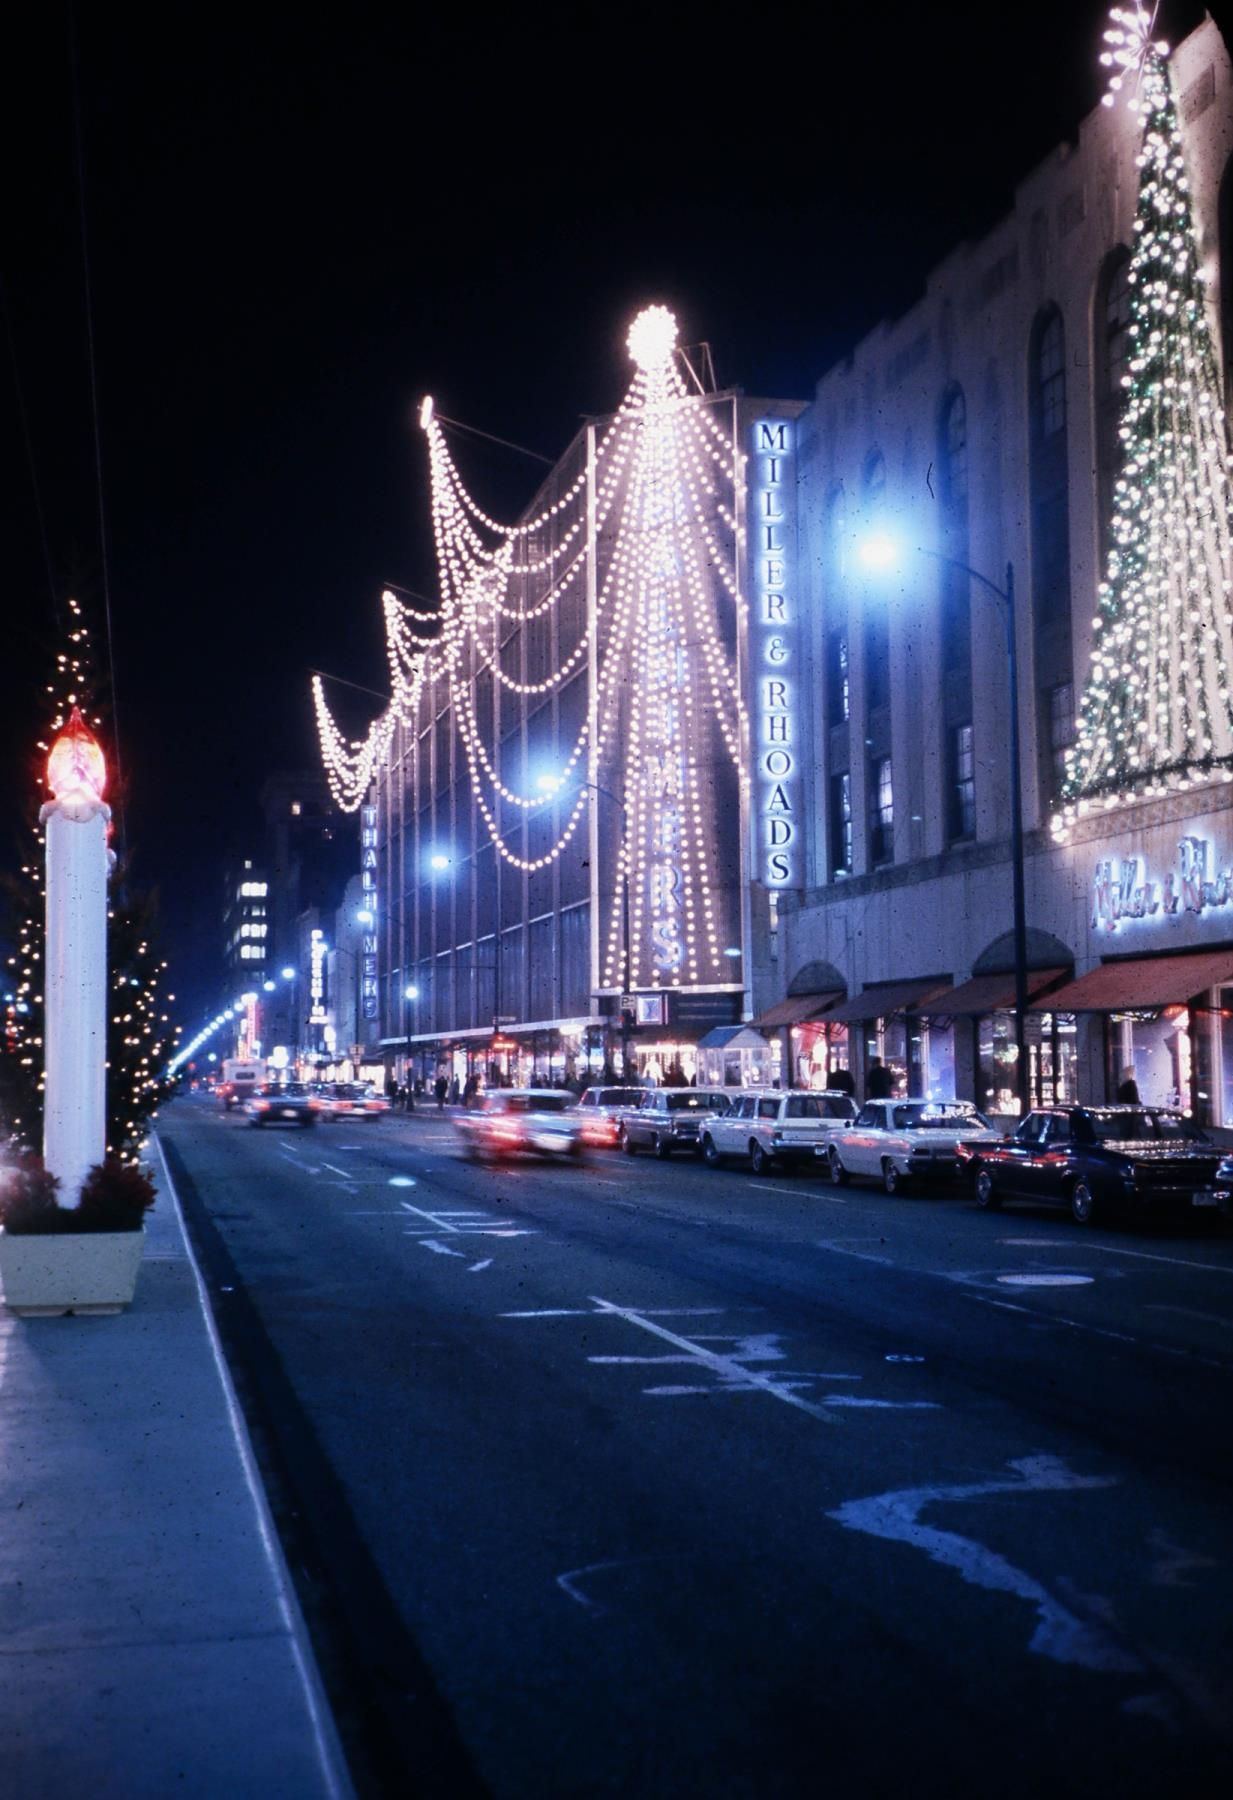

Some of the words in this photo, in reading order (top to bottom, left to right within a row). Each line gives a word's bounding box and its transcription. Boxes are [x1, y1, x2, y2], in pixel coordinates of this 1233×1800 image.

[759, 423, 788, 620] MILLER
[769, 638, 787, 661] &
[766, 681, 792, 881] RHOADS
[362, 808, 378, 1019] THALHIMERS
[1089, 858, 1158, 932] Miller
